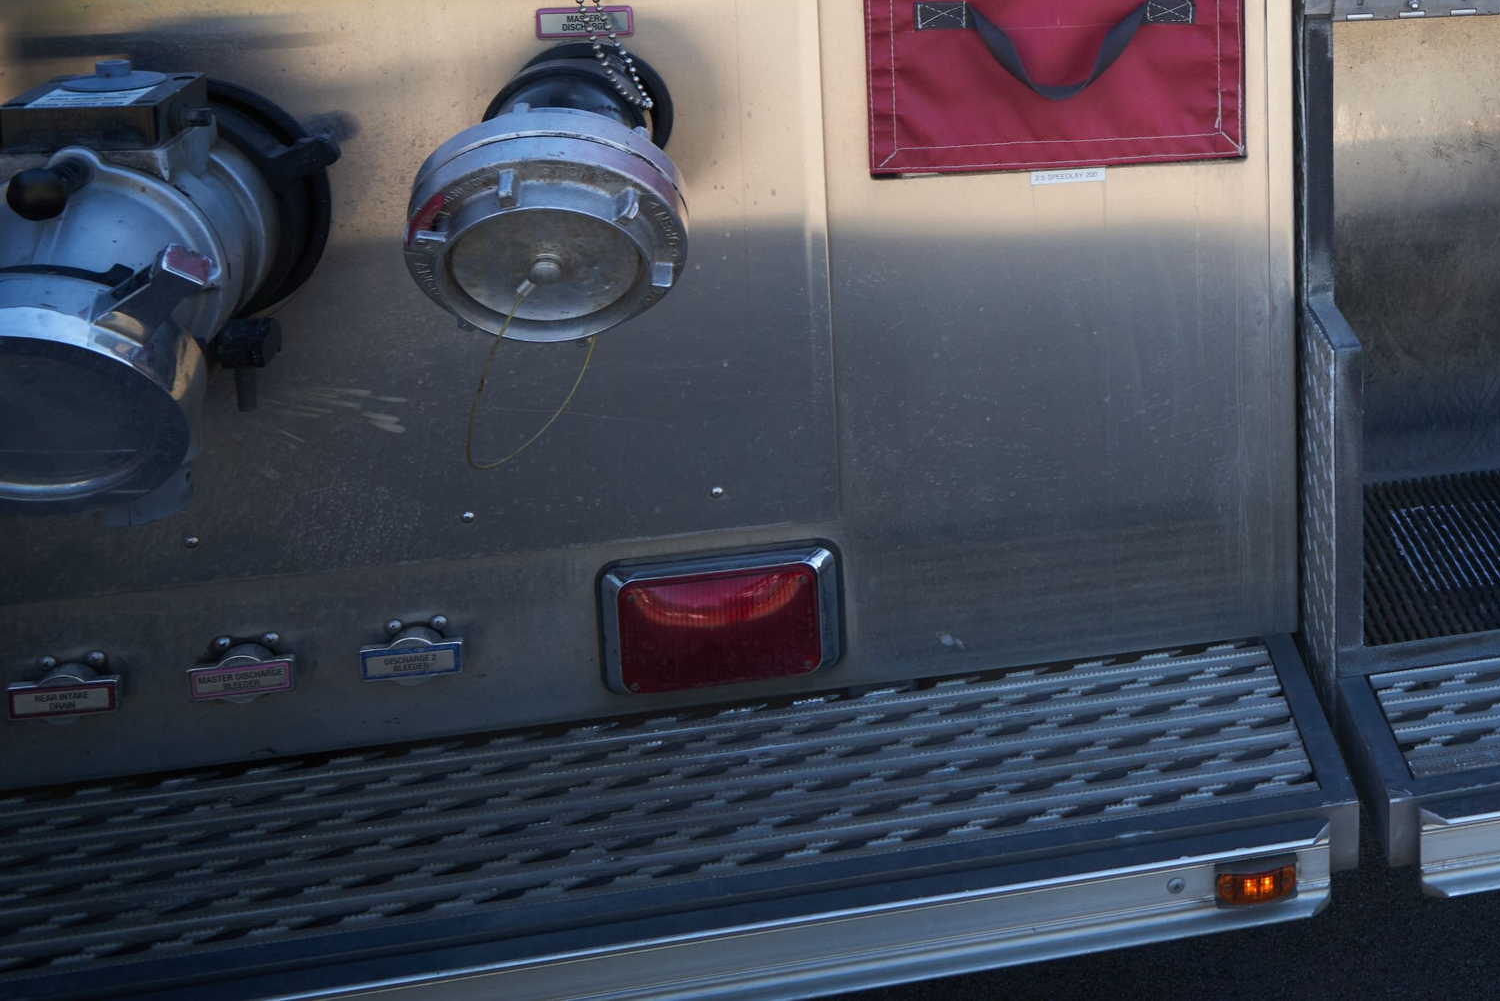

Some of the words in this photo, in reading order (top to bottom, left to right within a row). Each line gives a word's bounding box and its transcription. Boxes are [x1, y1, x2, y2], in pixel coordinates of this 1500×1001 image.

[566, 14, 600, 23] MASER
[561, 23, 607, 32] DISCHRG
[1047, 172, 1084, 181] SPEEDLAY
[384, 654, 430, 666] DISCHARGE
[431, 653, 437, 662] 2
[393, 662, 429, 672] BLEEDER
[198, 673, 234, 684] MASTER
[235, 667, 282, 679] DISCHARGE
[223, 679, 260, 691] BLEEDER
[34, 693, 57, 703] REAR
[59, 691, 89, 700] INTAKE
[49, 701, 76, 710] DRAIN
